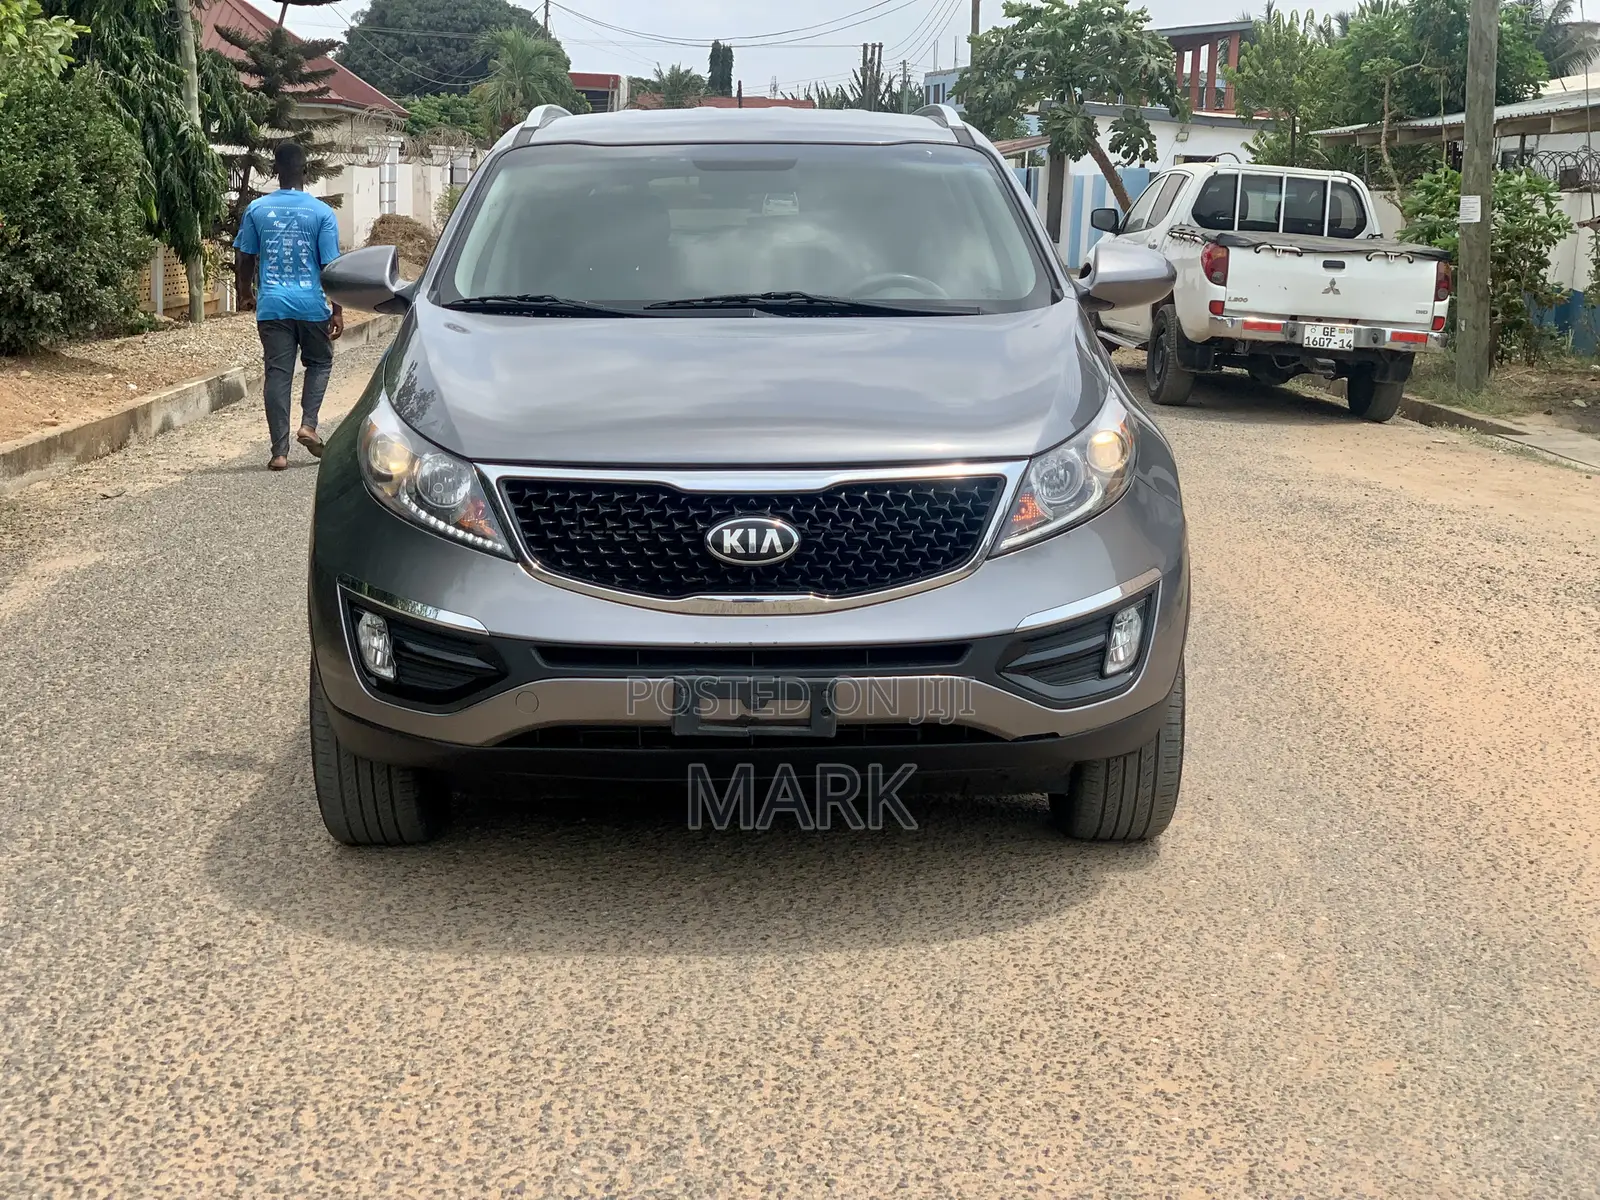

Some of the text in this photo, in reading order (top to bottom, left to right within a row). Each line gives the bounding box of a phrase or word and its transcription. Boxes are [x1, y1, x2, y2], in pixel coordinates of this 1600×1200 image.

[1322, 326, 1336, 337] GE
[1304, 336, 1353, 349] 1607-14
[722, 528, 784, 554] KIA
